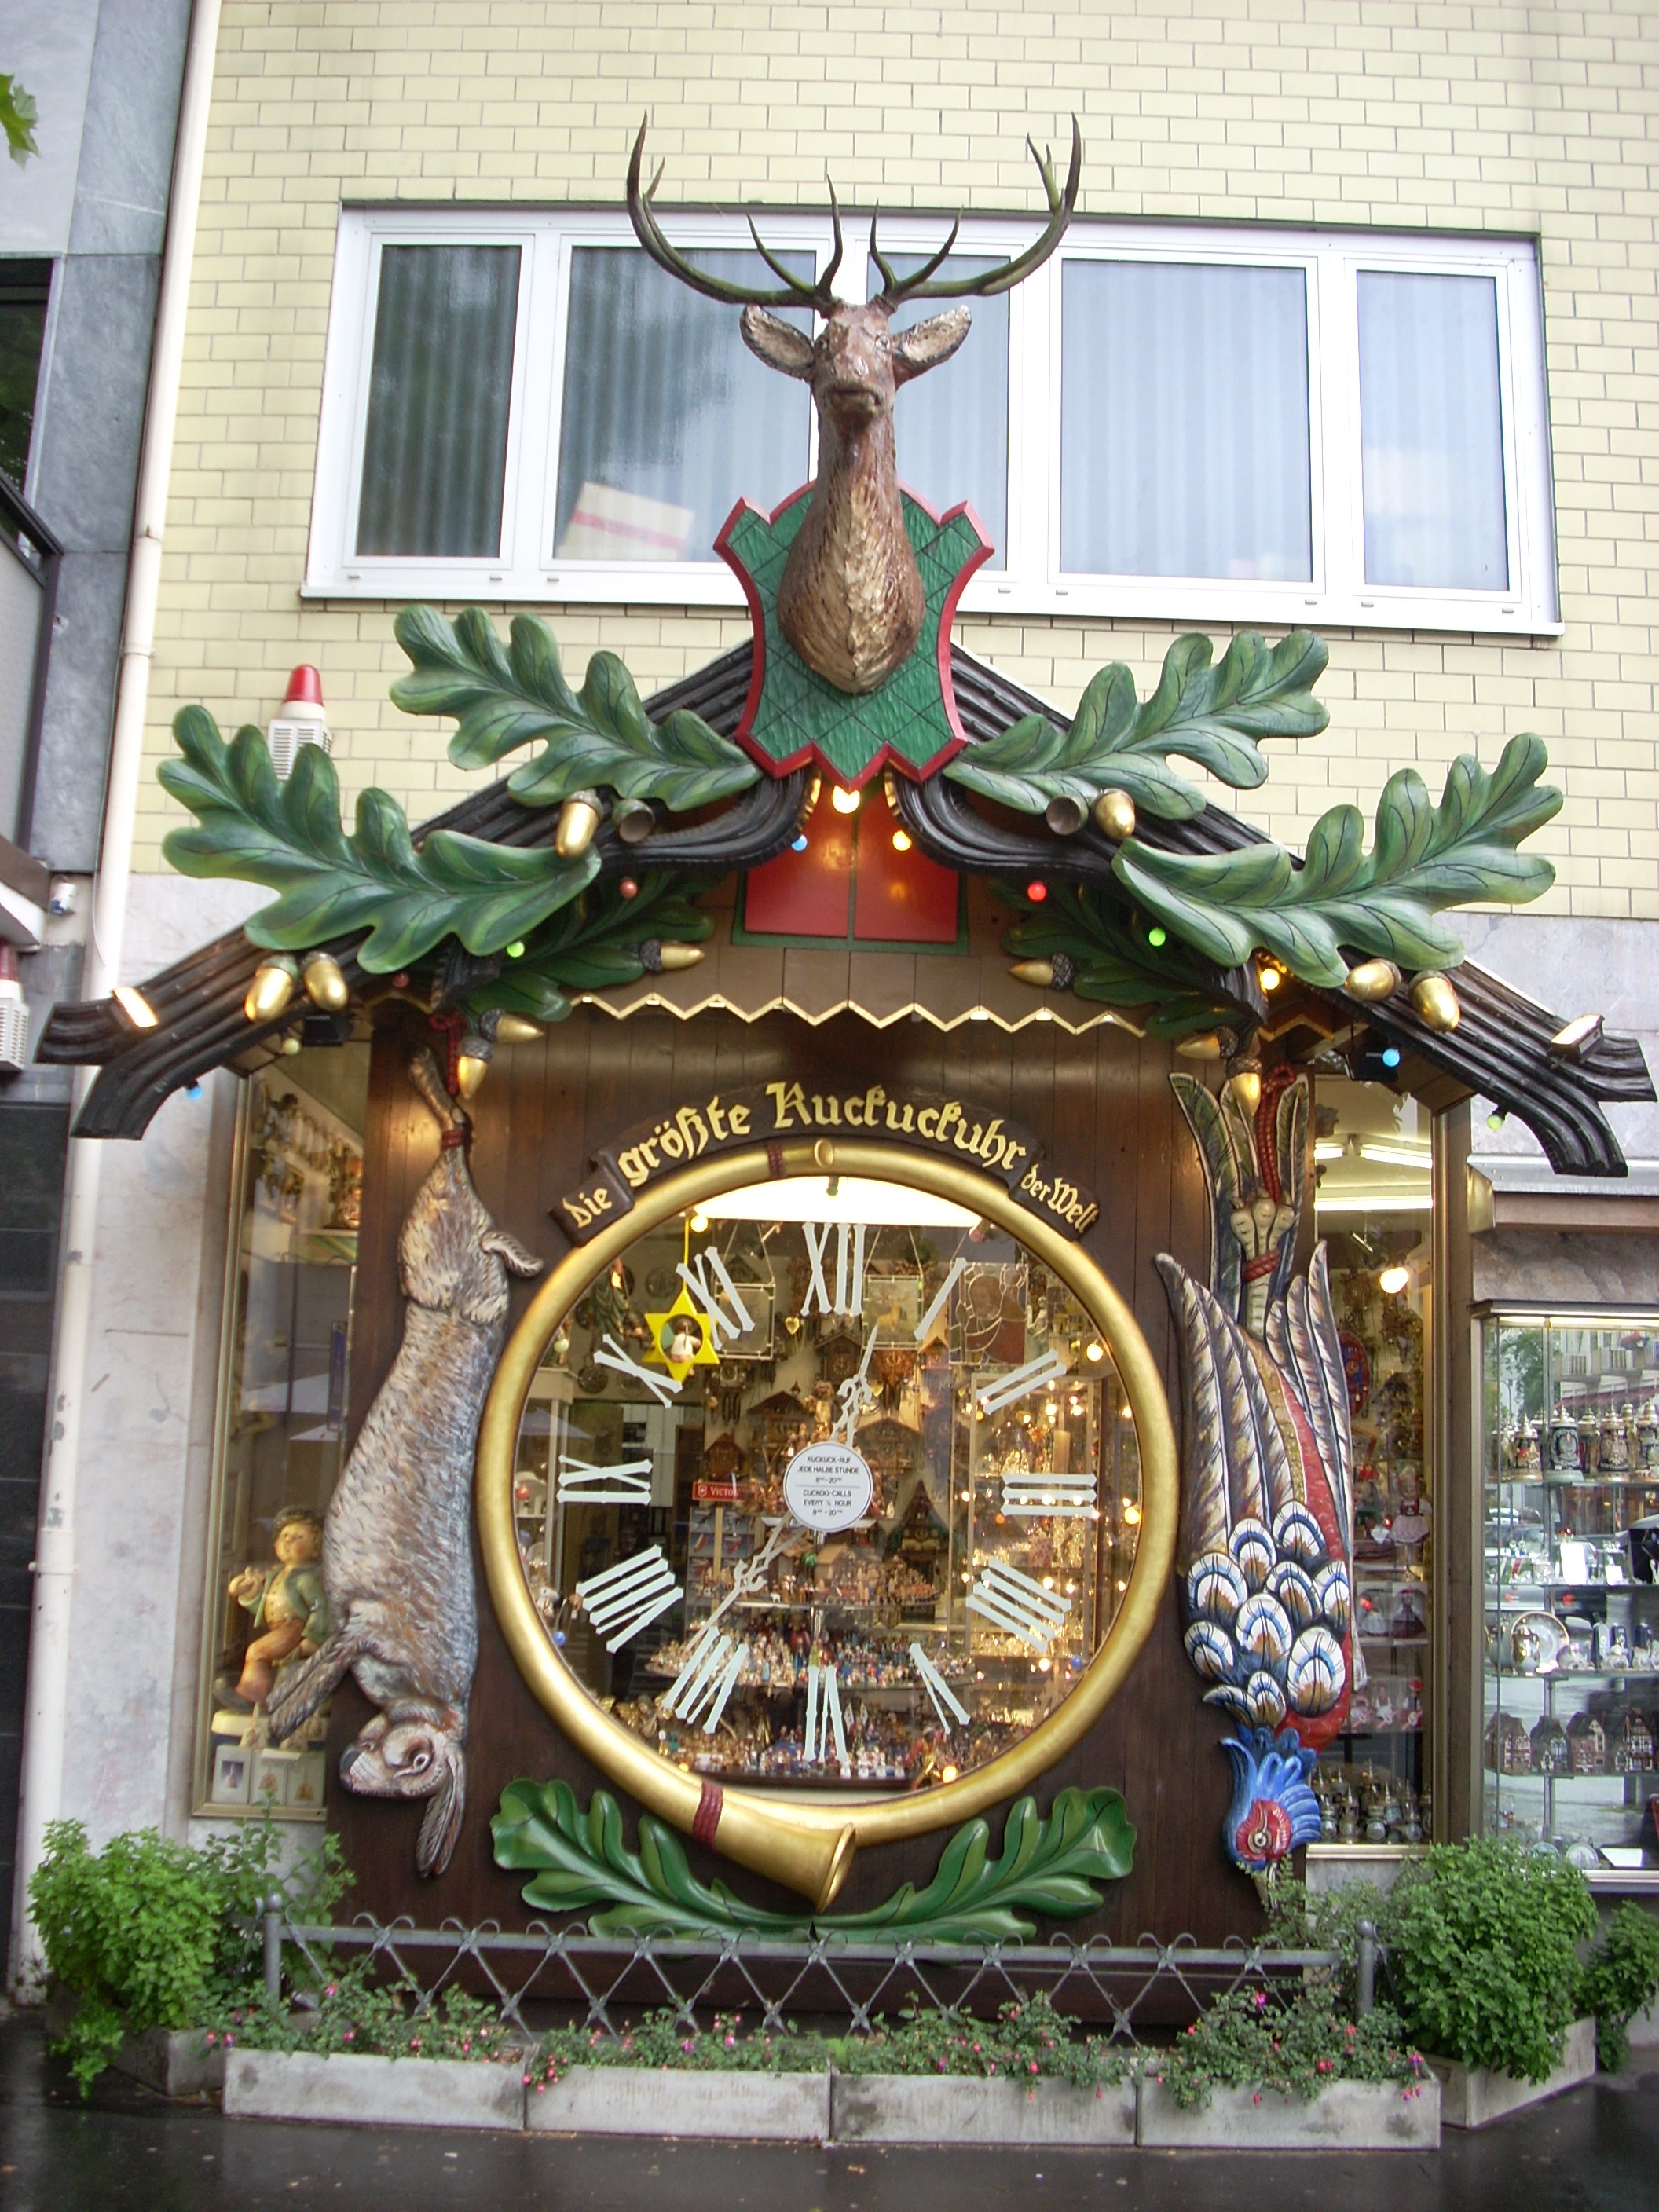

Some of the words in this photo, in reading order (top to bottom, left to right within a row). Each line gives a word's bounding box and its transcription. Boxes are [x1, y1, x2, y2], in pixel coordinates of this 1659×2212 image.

[617, 1095, 752, 1188] größte
[765, 1082, 1026, 1170] Kuckuckuhr
[1020, 1163, 1051, 1202] der
[1047, 1177, 1099, 1233] Welt
[676, 1247, 755, 1350] XI
[801, 1222, 865, 1317] XII
[593, 1334, 683, 1408] X
